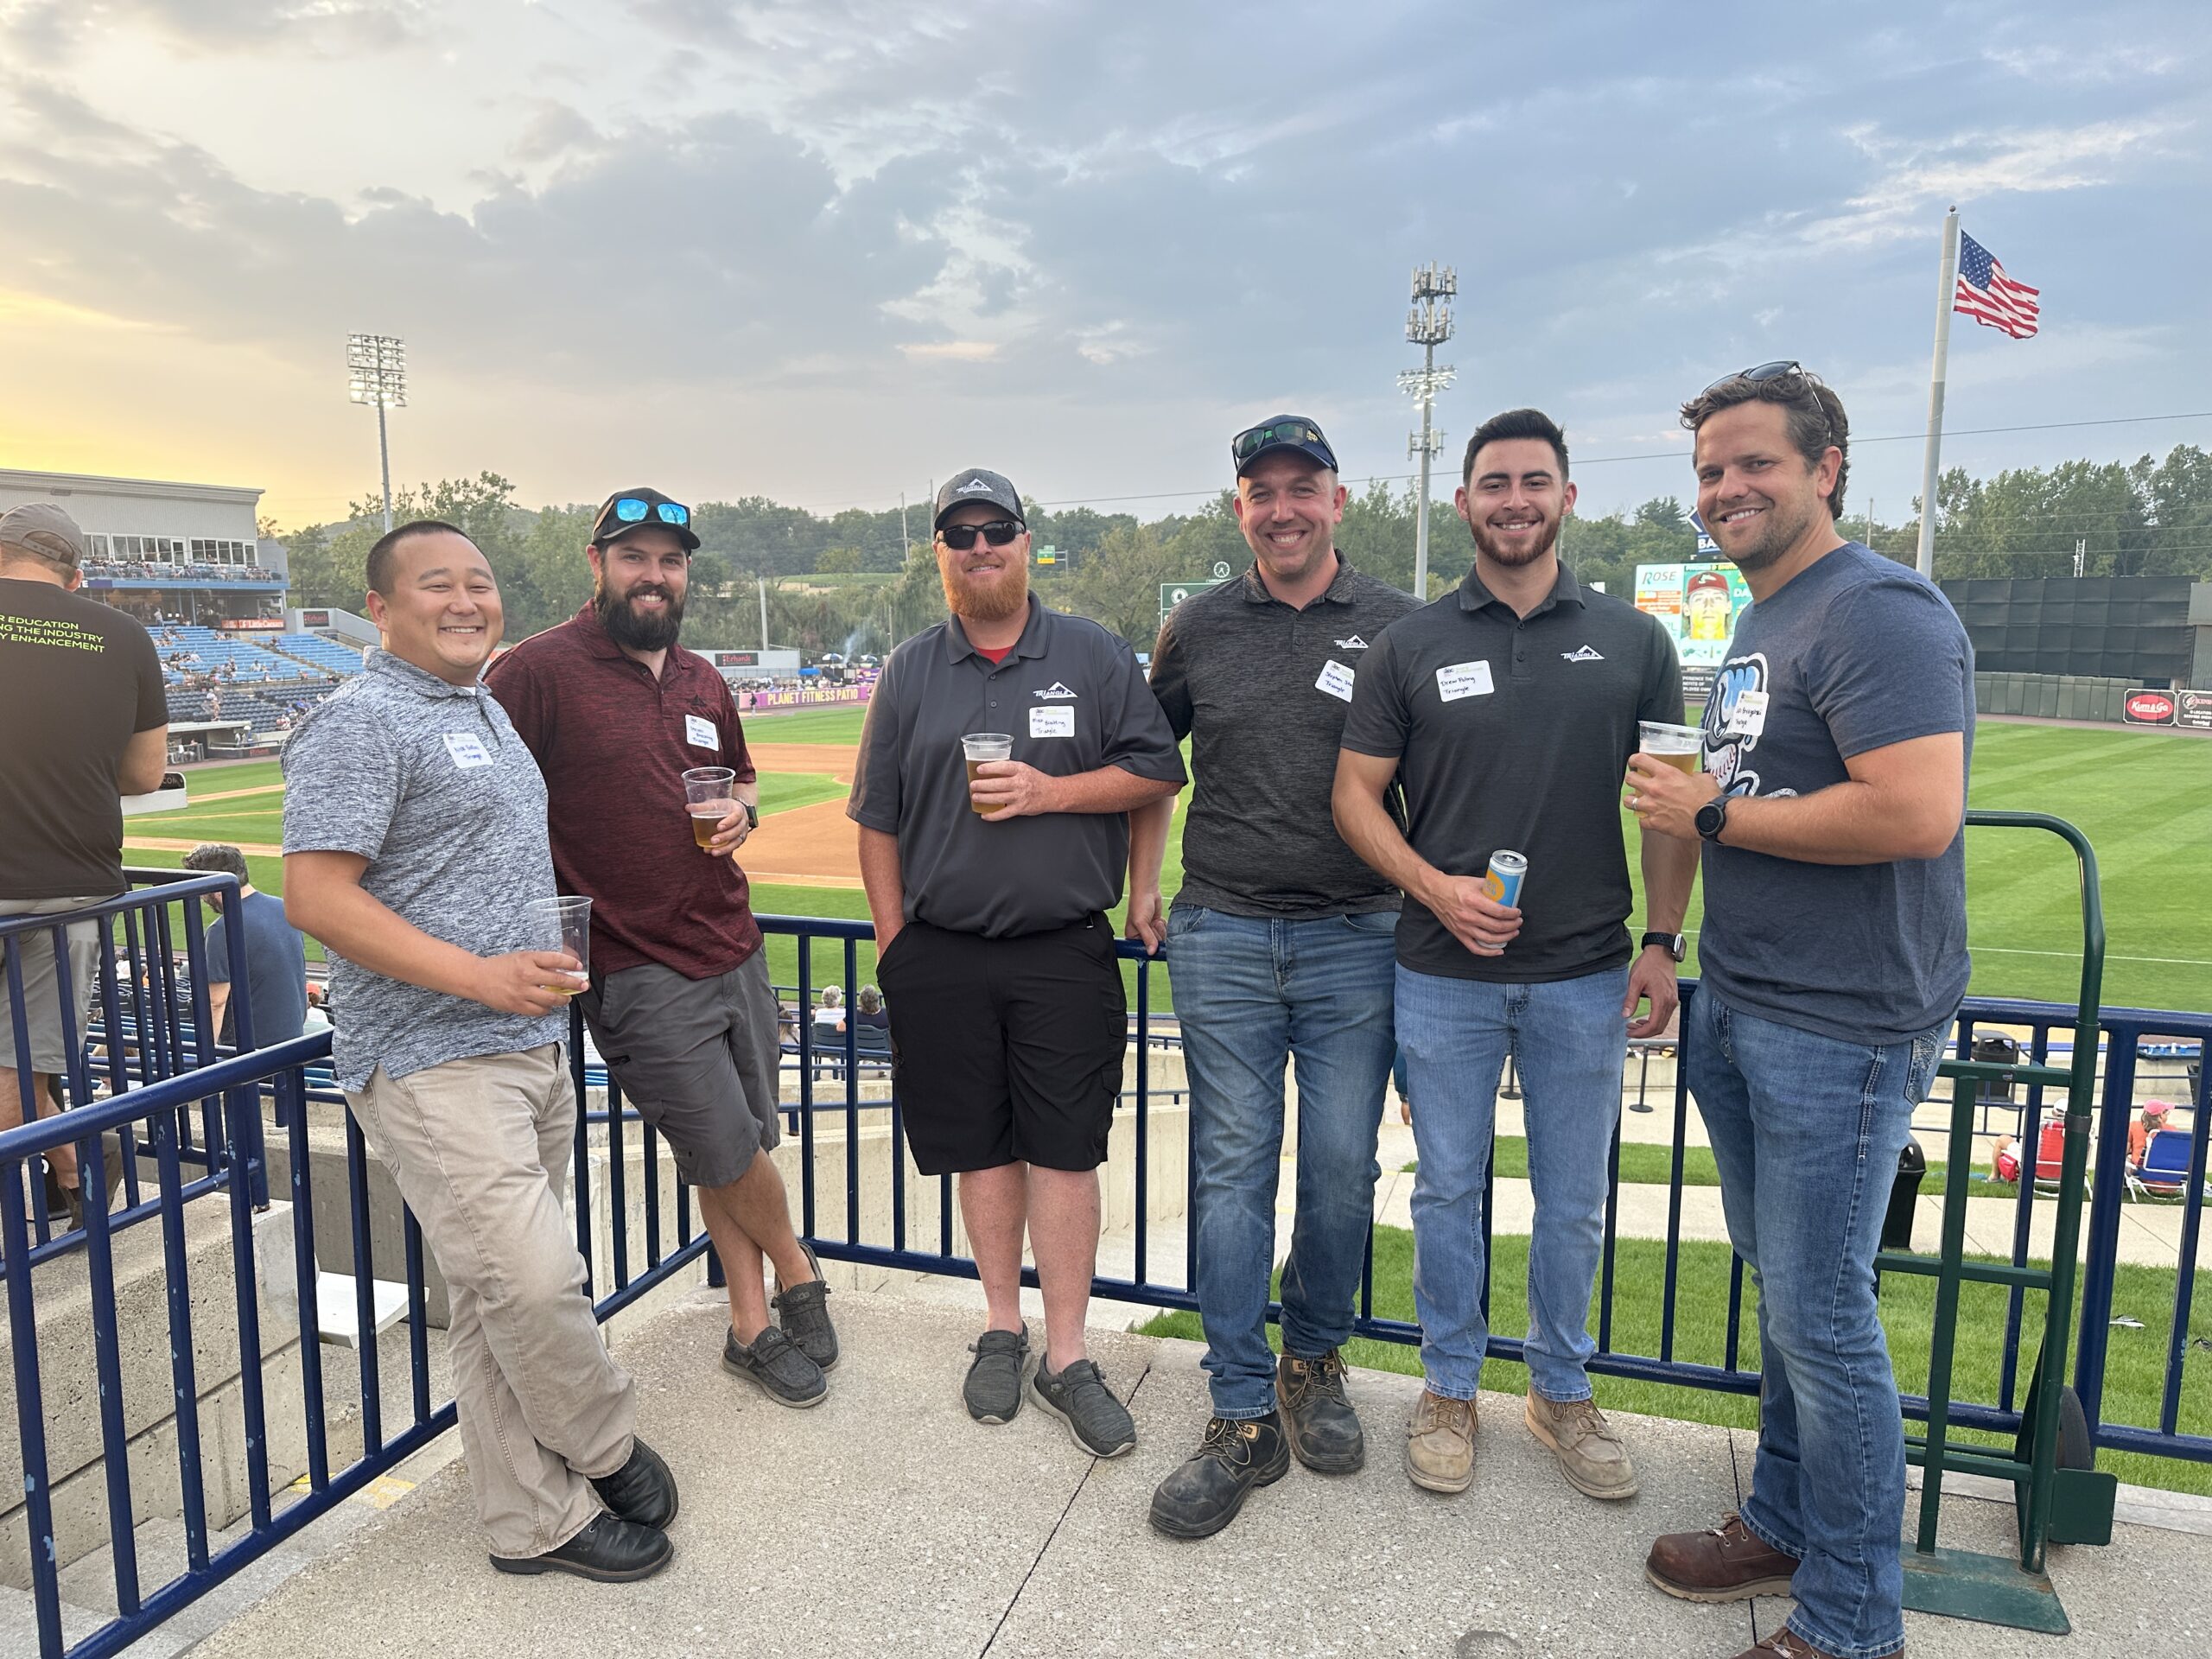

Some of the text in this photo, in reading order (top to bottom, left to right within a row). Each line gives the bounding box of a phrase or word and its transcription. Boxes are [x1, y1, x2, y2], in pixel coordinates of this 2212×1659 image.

[1643, 571, 1677, 585] ROSE
[8, 616, 79, 630] EDUCATION
[16, 626, 41, 635] THE
[44, 629, 104, 643] INDUSTRY
[10, 634, 105, 653] ENHANCEMENT
[726, 654, 751, 663] Erhardt
[767, 688, 858, 706] PLANET FITNESS PATIO
